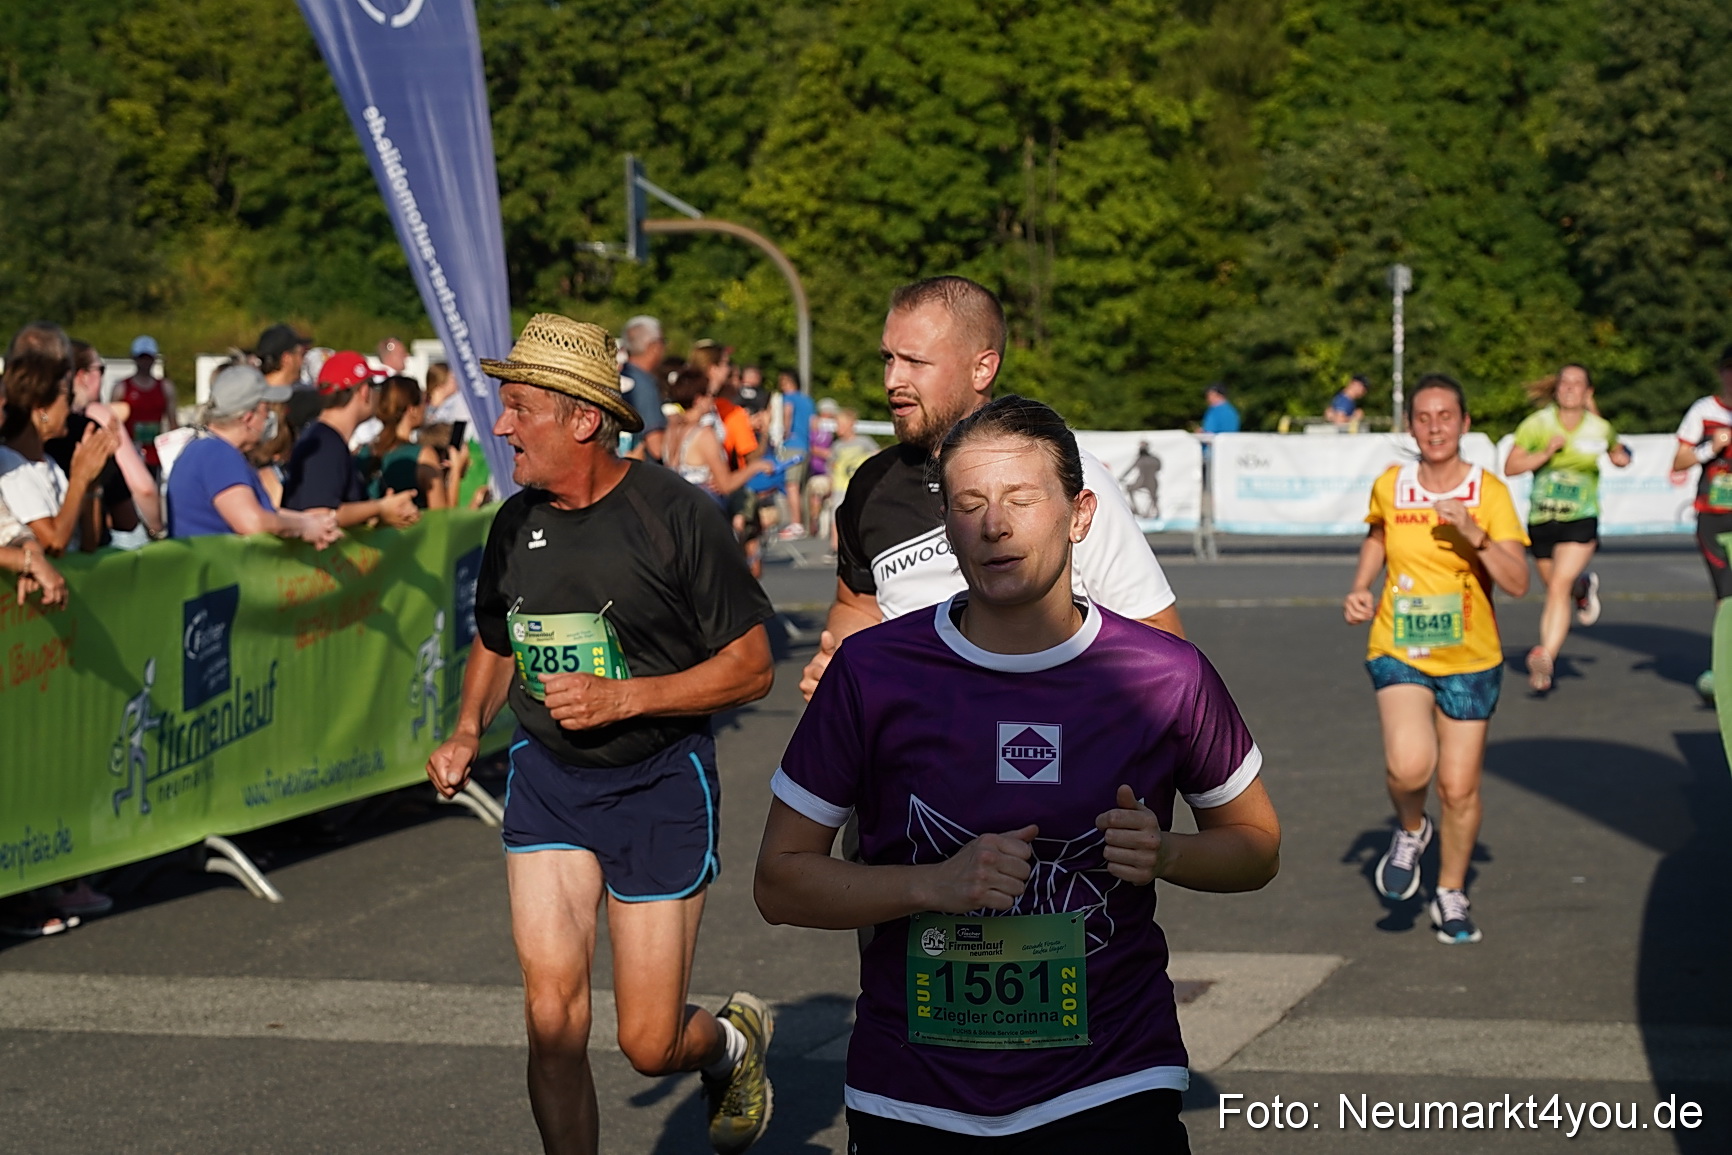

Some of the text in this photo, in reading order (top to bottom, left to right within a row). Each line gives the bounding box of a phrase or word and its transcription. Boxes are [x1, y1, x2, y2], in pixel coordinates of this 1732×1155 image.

[1395, 513, 1429, 524] MAX
[880, 540, 955, 582] INWOO
[1406, 613, 1452, 630] 1649
[528, 645, 580, 673] 285
[592, 646, 606, 677] 022
[1001, 747, 1057, 759] FUCHS
[949, 939, 1004, 951] Firmenlauf
[969, 949, 1003, 957] neumarkt
[935, 961, 1049, 1005] 1561
[916, 973, 932, 1018] RUN
[1061, 966, 1078, 1027] 2022
[933, 1006, 1059, 1025] Ziegler Corinna
